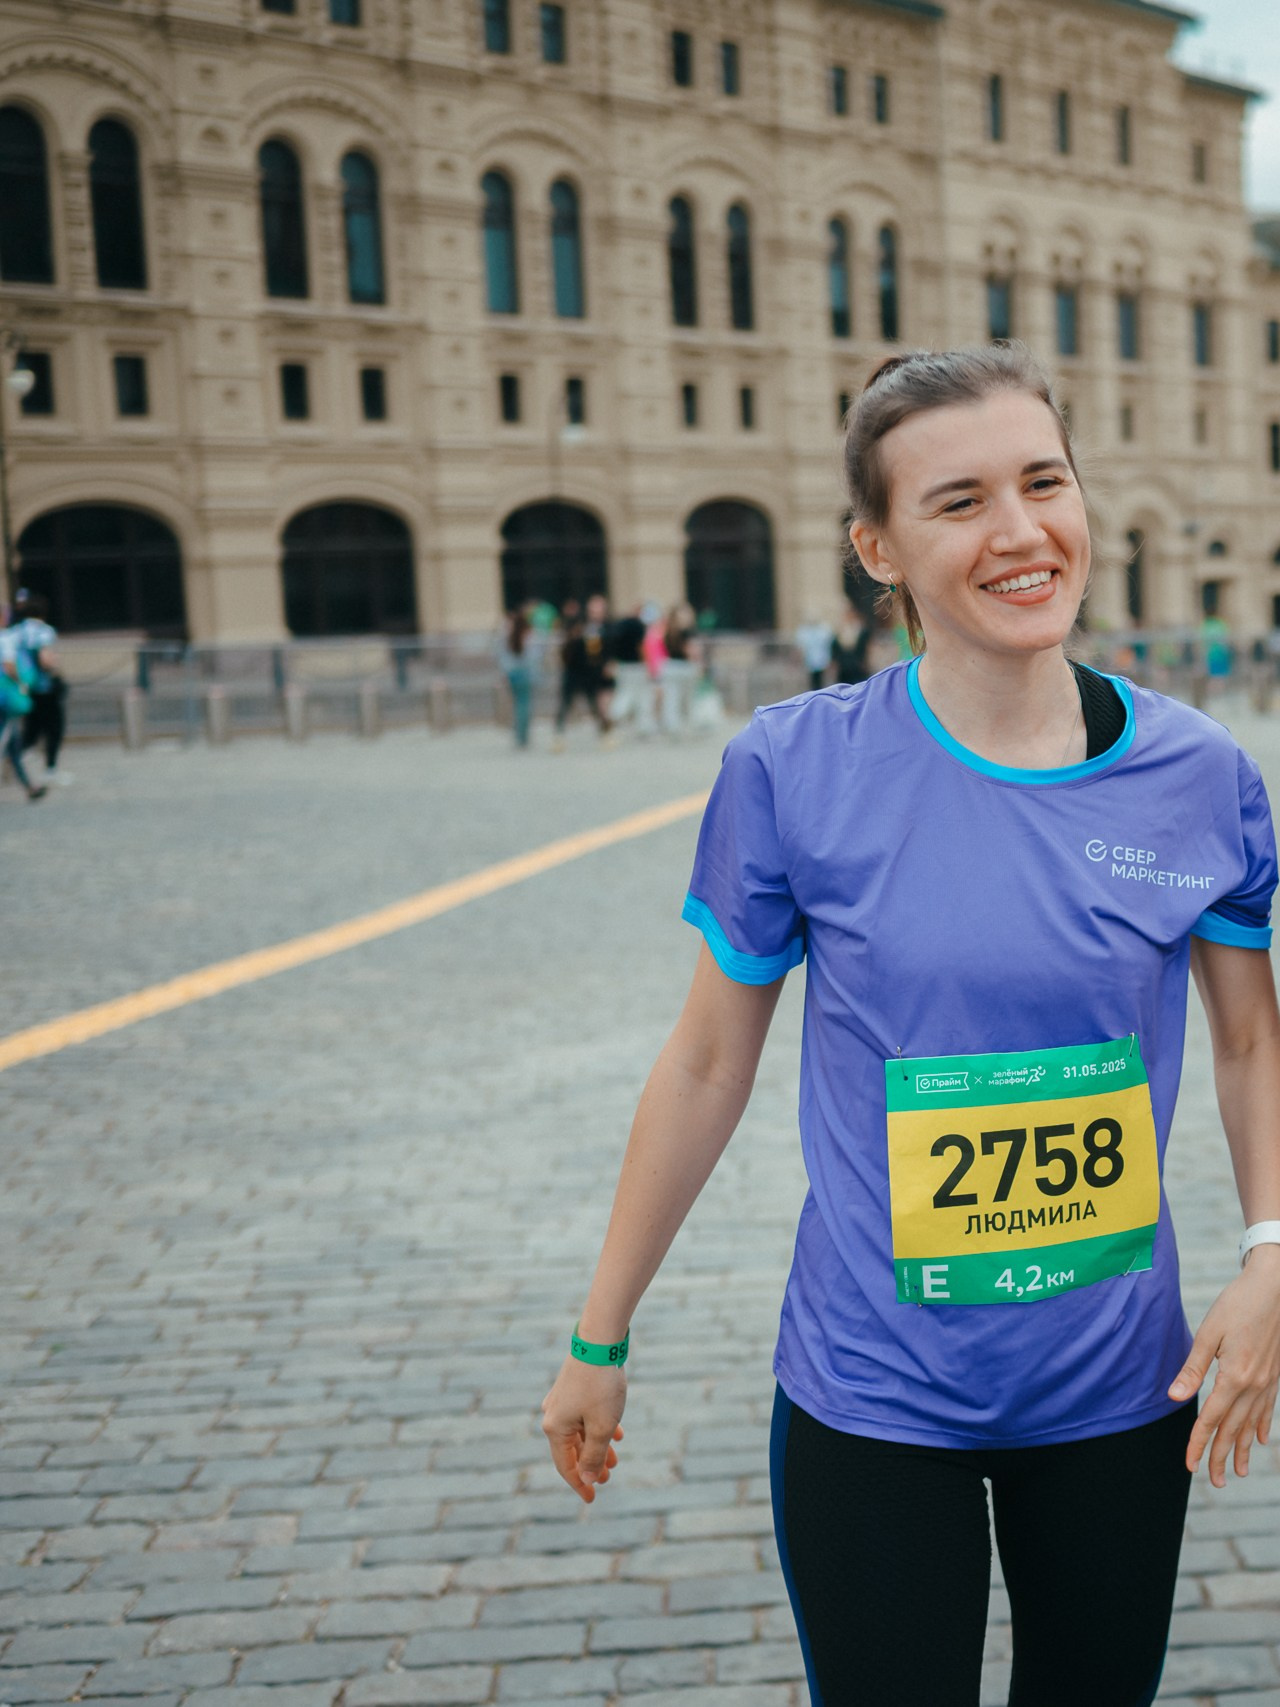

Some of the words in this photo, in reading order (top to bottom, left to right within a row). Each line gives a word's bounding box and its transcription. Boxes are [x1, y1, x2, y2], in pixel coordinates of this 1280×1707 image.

[1112, 846, 1156, 865] СБЕР
[1111, 863, 1215, 889] МАРКЕТИНГ
[993, 1067, 1029, 1078] зелёный
[1063, 1058, 1126, 1079] 31.05.2025
[931, 1078, 961, 1088] Прайм
[988, 1076, 1026, 1086] марафон
[930, 1117, 1124, 1209] 2758
[965, 1200, 1097, 1235] ЛЮДМИЛА
[994, 1265, 1043, 1297] 4,2
